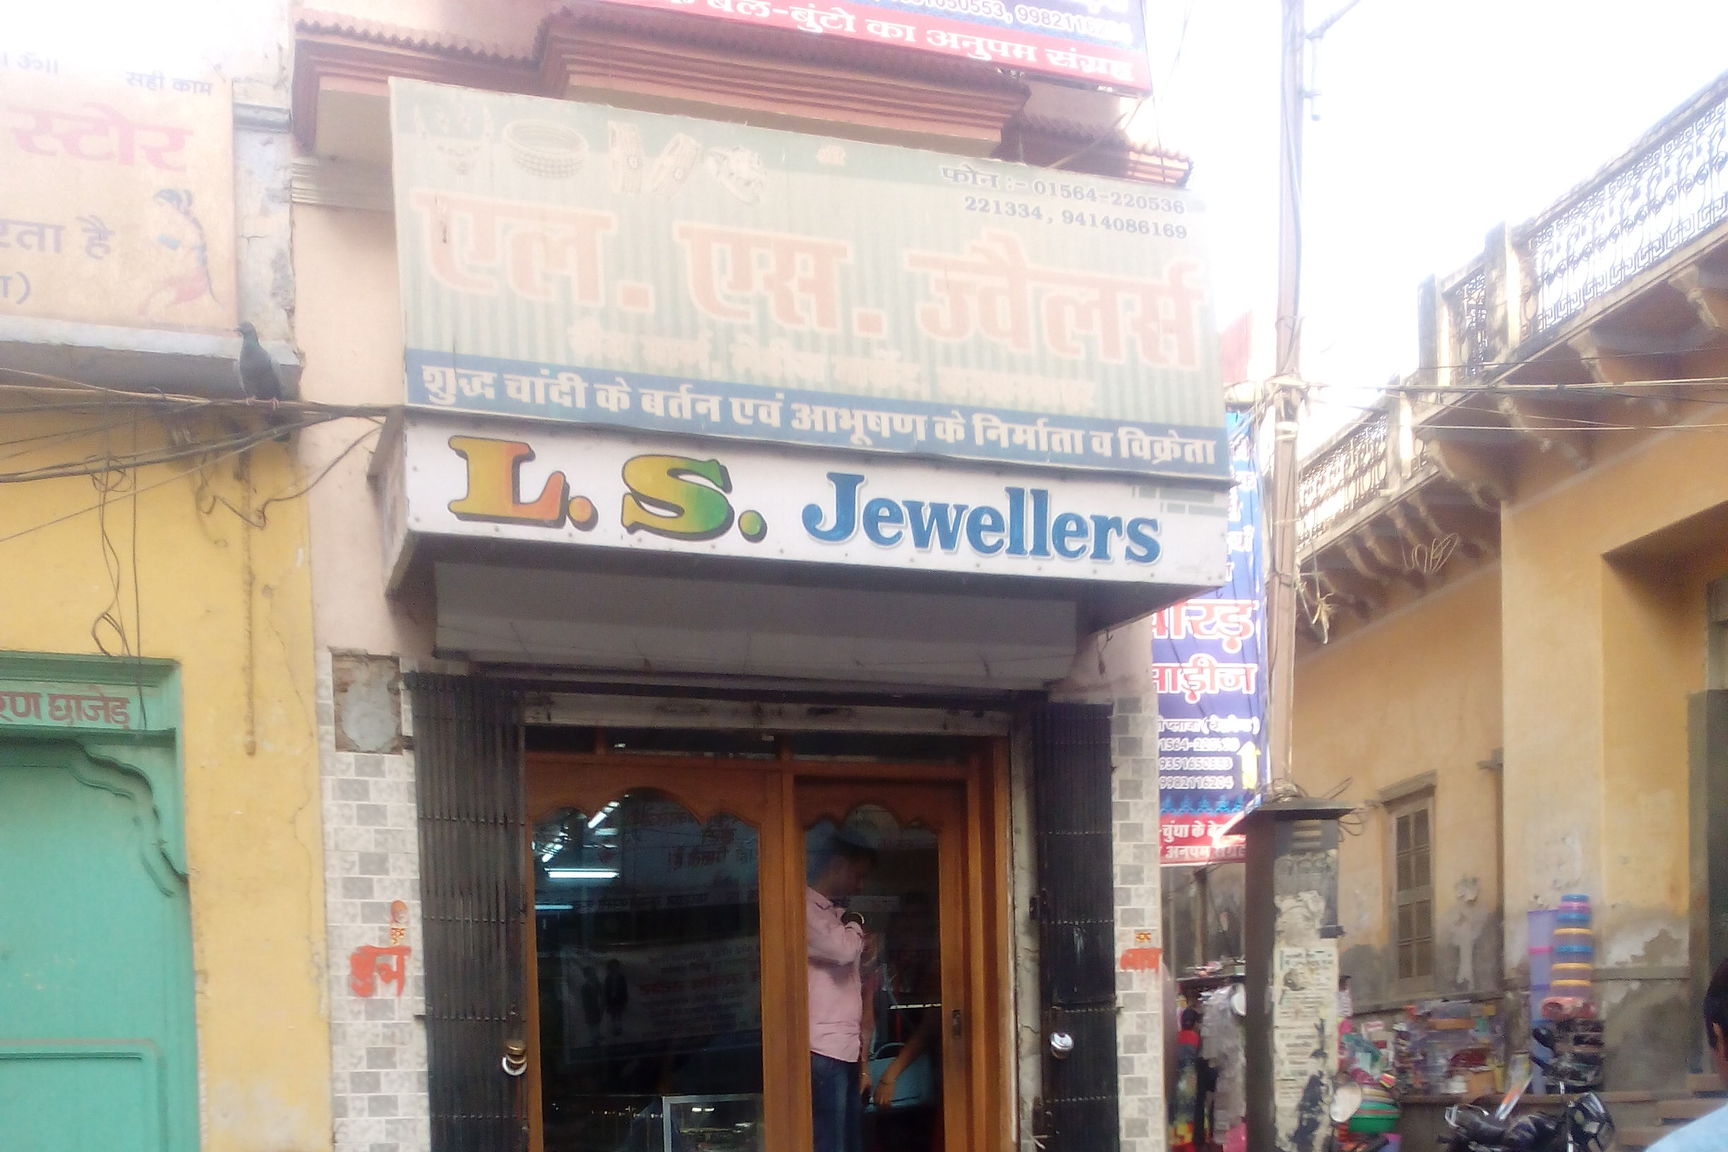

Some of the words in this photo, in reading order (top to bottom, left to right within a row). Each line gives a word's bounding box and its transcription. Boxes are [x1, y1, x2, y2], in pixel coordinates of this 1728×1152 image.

[866, 18, 917, 42] का
[925, 28, 1038, 61] अनुपम
[125, 70, 165, 92] सही
[171, 77, 213, 97] काम
[942, 163, 999, 190] फोन
[1032, 179, 1186, 216] 01564-220536
[76, 213, 116, 261] है
[1061, 208, 1188, 240] 9414086169
[410, 188, 655, 316] एल.
[673, 218, 888, 340] एस.
[422, 366, 498, 406] शुद्ध
[503, 369, 589, 410] चांदी
[595, 376, 632, 413] के
[639, 384, 722, 424] बर्तन
[727, 392, 784, 428] एवं
[791, 402, 926, 447] आभूषण
[931, 410, 967, 444] के
[971, 413, 1085, 457] निर्माता
[1089, 430, 1113, 459] व
[1117, 426, 1217, 466] विक्रेता
[448, 434, 599, 533] L.
[622, 453, 768, 543] S.
[801, 472, 1163, 564] Jewellers
